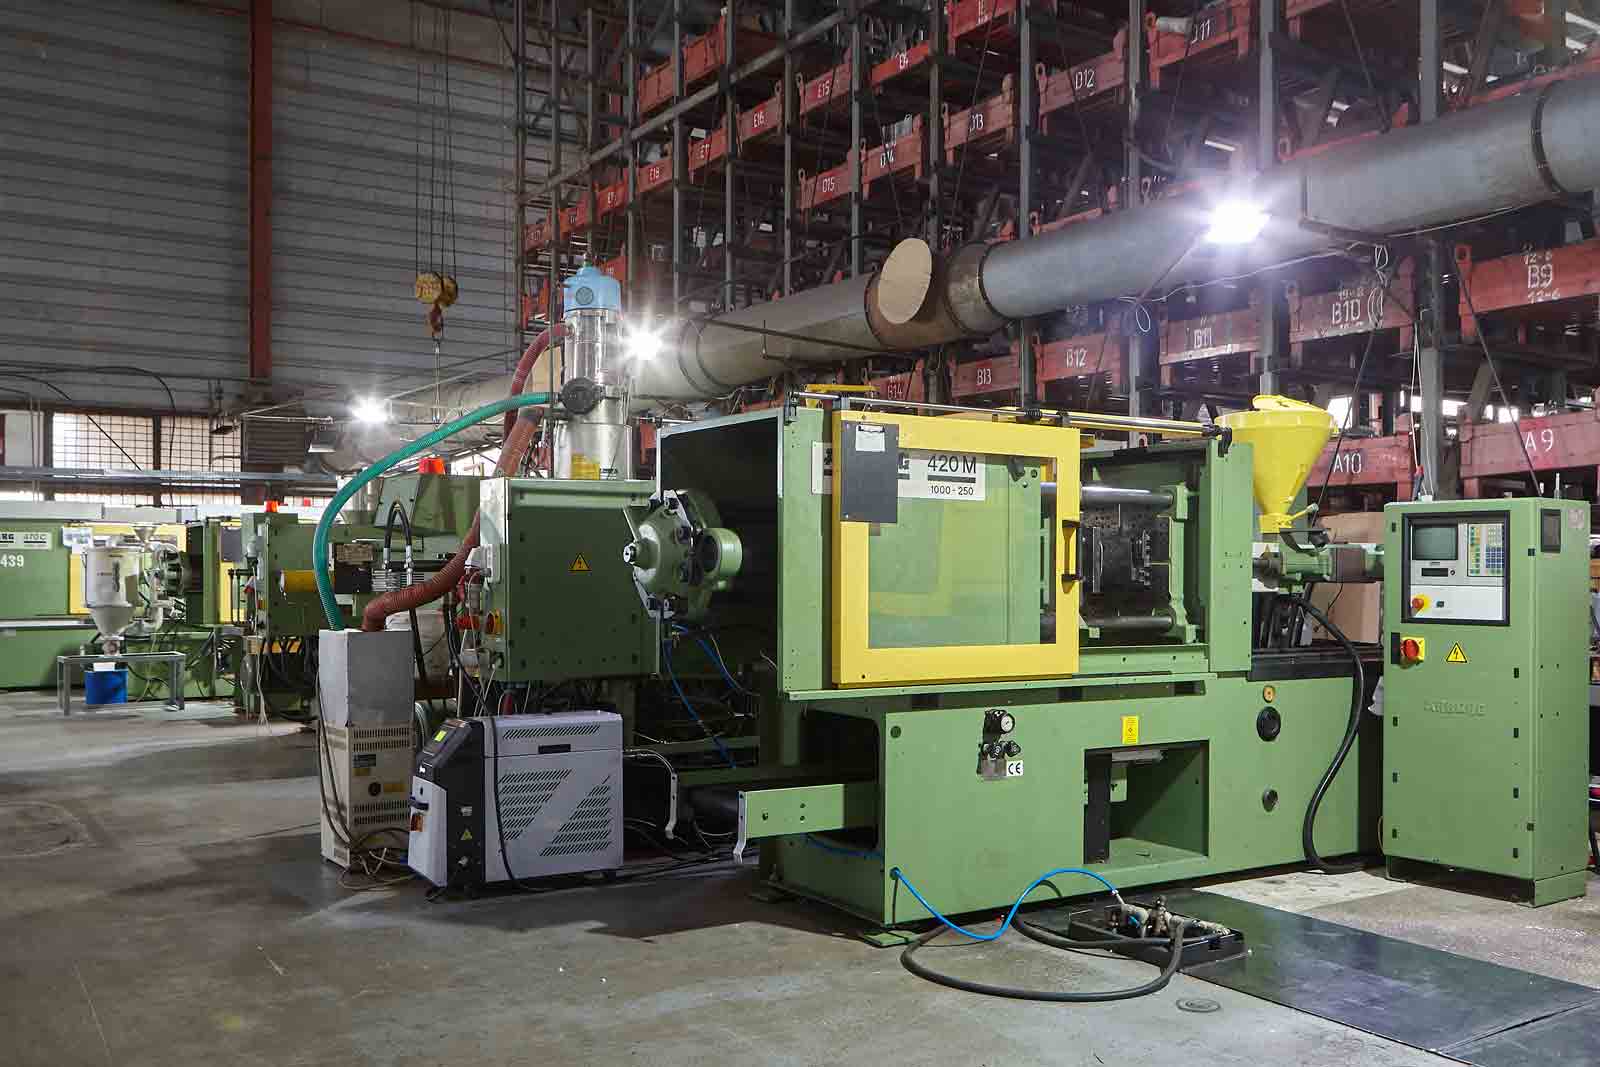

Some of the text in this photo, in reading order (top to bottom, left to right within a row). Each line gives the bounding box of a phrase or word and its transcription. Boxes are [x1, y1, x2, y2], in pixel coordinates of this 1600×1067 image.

[1075, 69, 1095, 88] D12
[817, 80, 830, 98] E15
[1527, 264, 1552, 288] B9
[1332, 300, 1360, 325] B10
[1066, 348, 1087, 368] B12
[976, 368, 992, 385] B13
[928, 455, 959, 472] 420
[963, 455, 977, 474] M
[1333, 452, 1361, 474] A10
